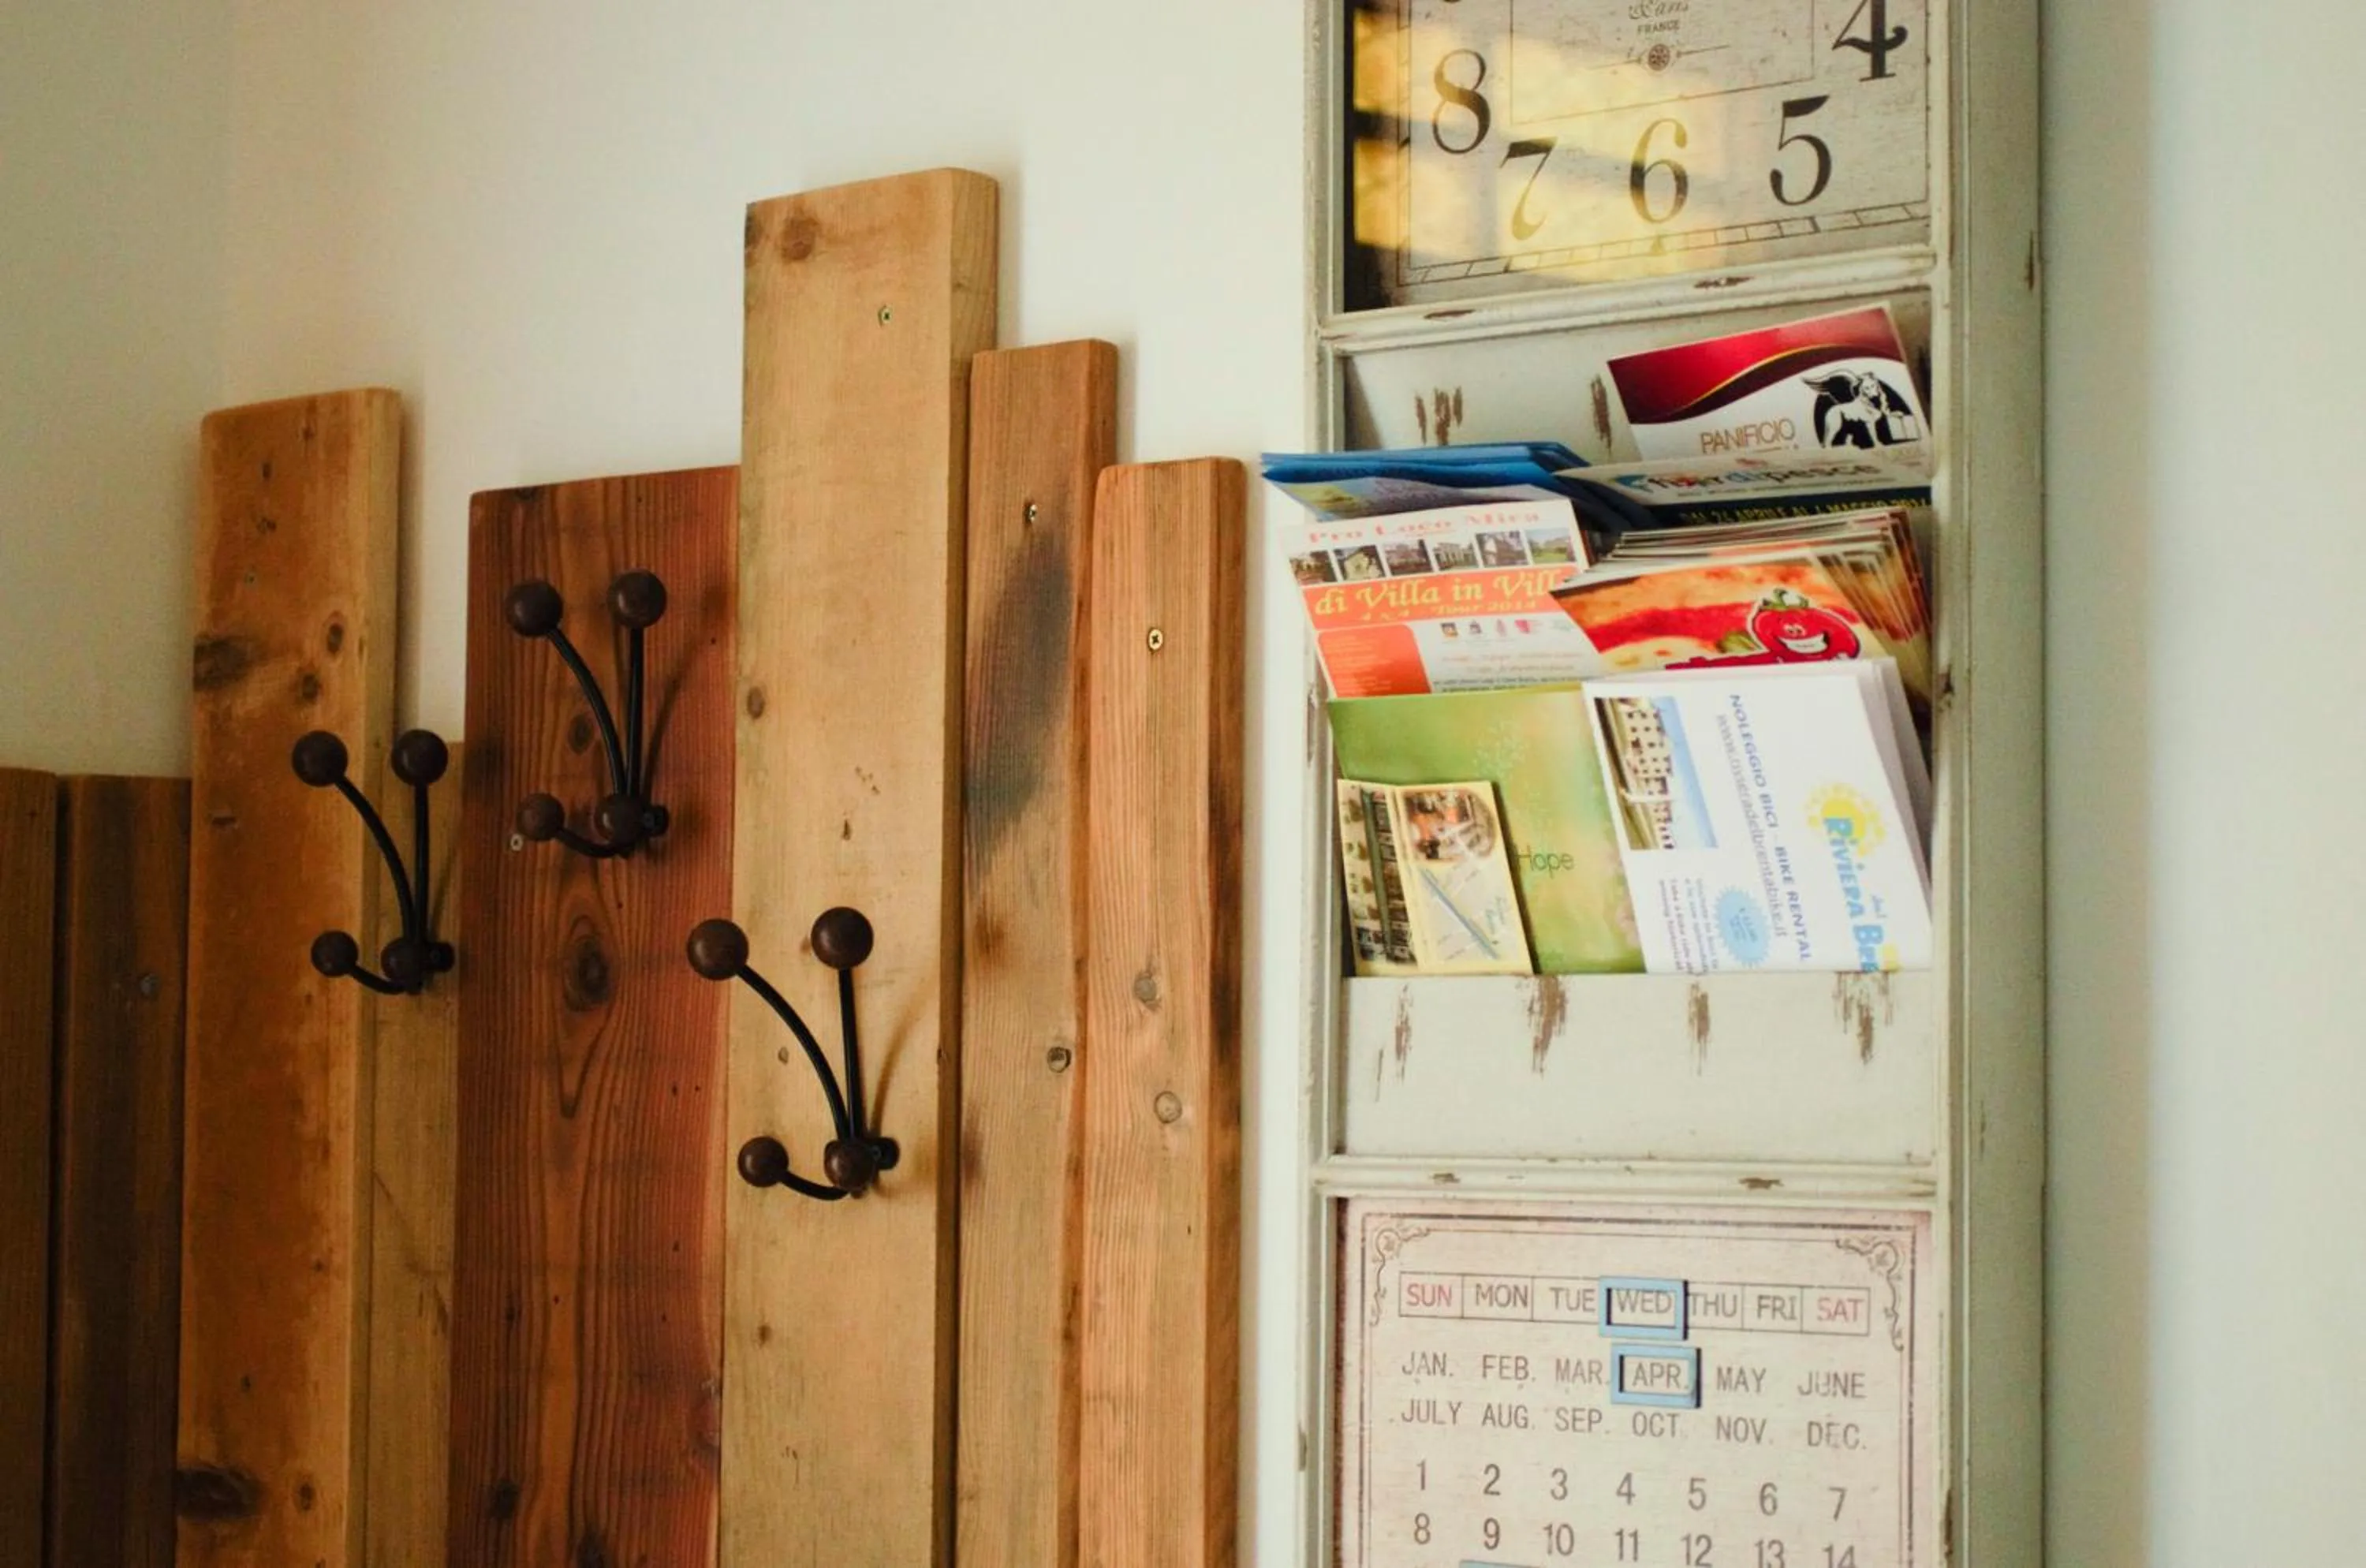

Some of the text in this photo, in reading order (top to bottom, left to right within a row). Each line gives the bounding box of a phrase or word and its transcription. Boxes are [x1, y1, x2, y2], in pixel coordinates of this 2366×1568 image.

[1831, 0, 1909, 82] 4
[1431, 48, 1491, 154] 8
[1629, 118, 1689, 223] 6
[1769, 95, 1831, 206] 5
[1499, 136, 1558, 240] 7
[1700, 417, 1796, 454] PANIFICIO
[1315, 568, 1561, 615] di Villa in Vill
[1729, 693, 1768, 794] NOLEGGIO
[1758, 793, 1779, 828] BICI
[1774, 846, 1795, 886] BIKE
[1786, 890, 1812, 962] RENTAL
[1514, 844, 1575, 879] Hope
[1405, 1284, 1864, 1323] SUN MON TUE WED THU FRI SAT
[1401, 1351, 1867, 1399] JAN. FEB. MAR. APR. MAY JUNE
[1401, 1398, 1462, 1427] JULY
[1481, 1402, 1536, 1430] AUG.
[1554, 1406, 1610, 1435] SEP.
[1807, 1421, 1867, 1450] DEC.
[1416, 1459, 1847, 1521] 1 2 3 4 5 6 7
[1413, 1513, 1857, 1568] 8 9 10 11 12 13 14
